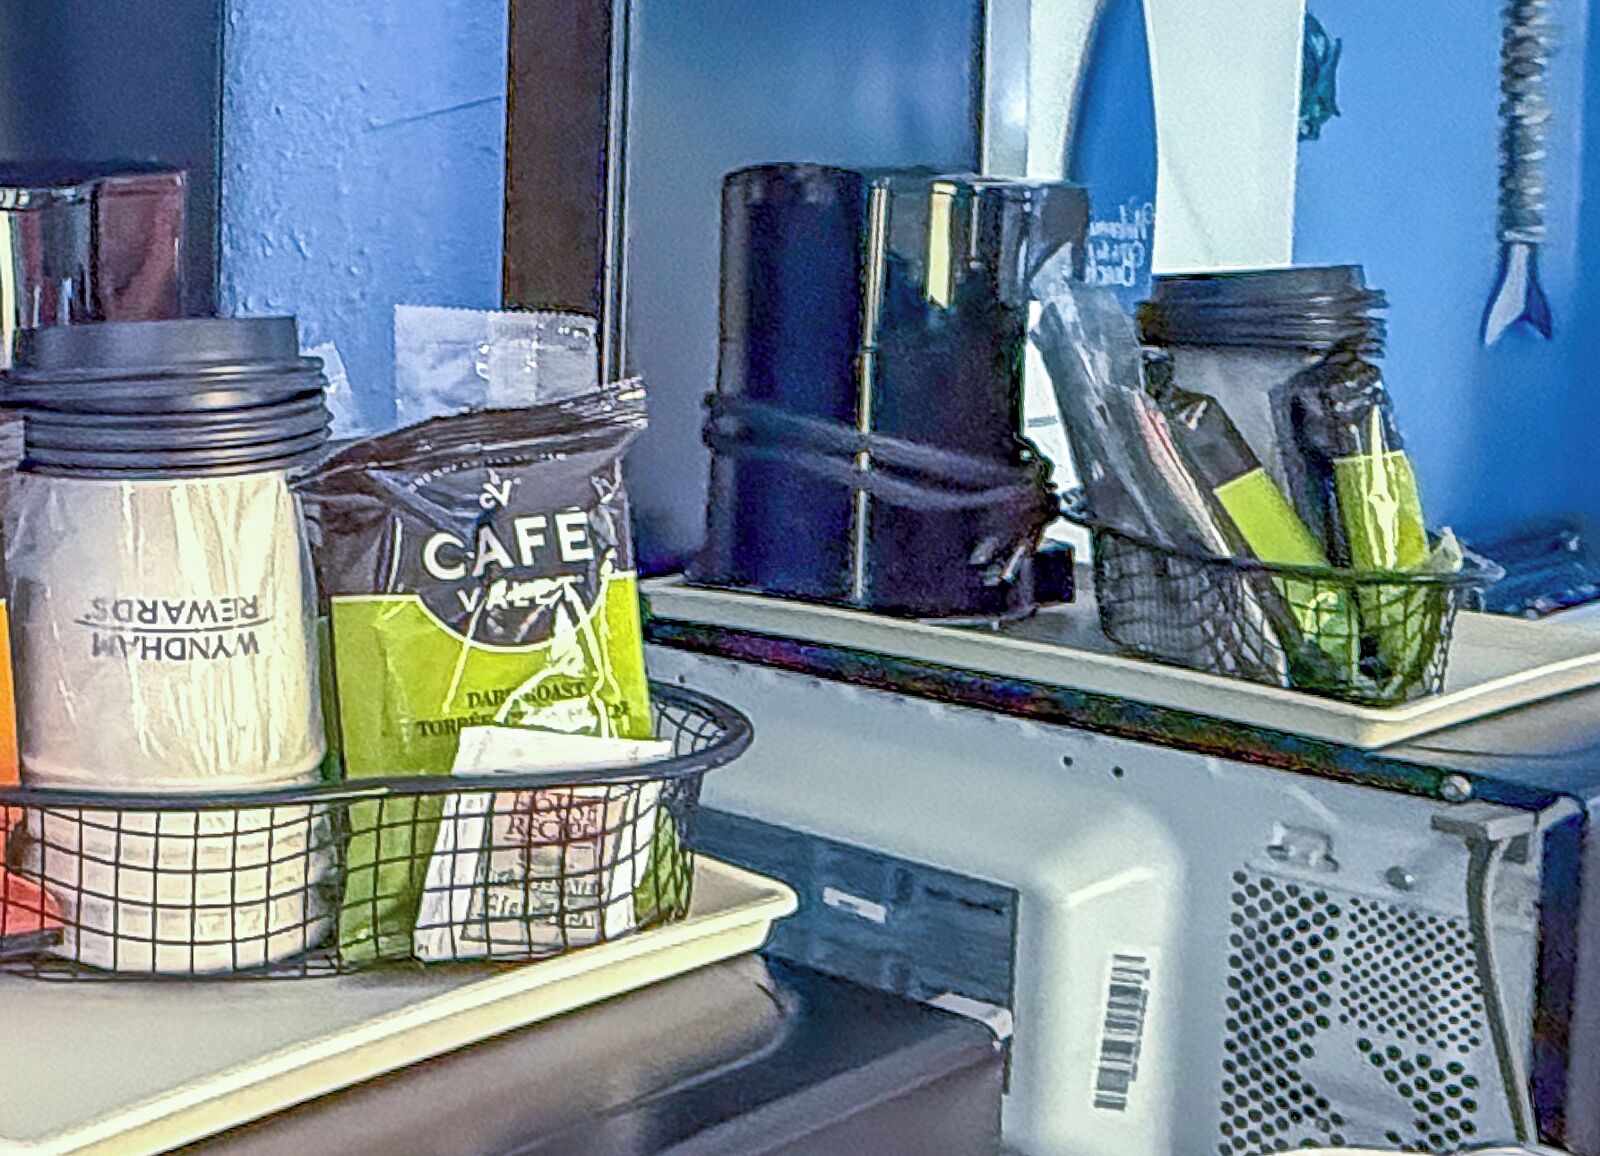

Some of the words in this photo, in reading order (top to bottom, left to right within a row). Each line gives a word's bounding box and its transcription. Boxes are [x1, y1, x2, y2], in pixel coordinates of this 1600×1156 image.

[90, 595, 260, 626] REWARDS
[92, 631, 261, 661] WYNDHAM
[466, 686, 516, 709] DAR
